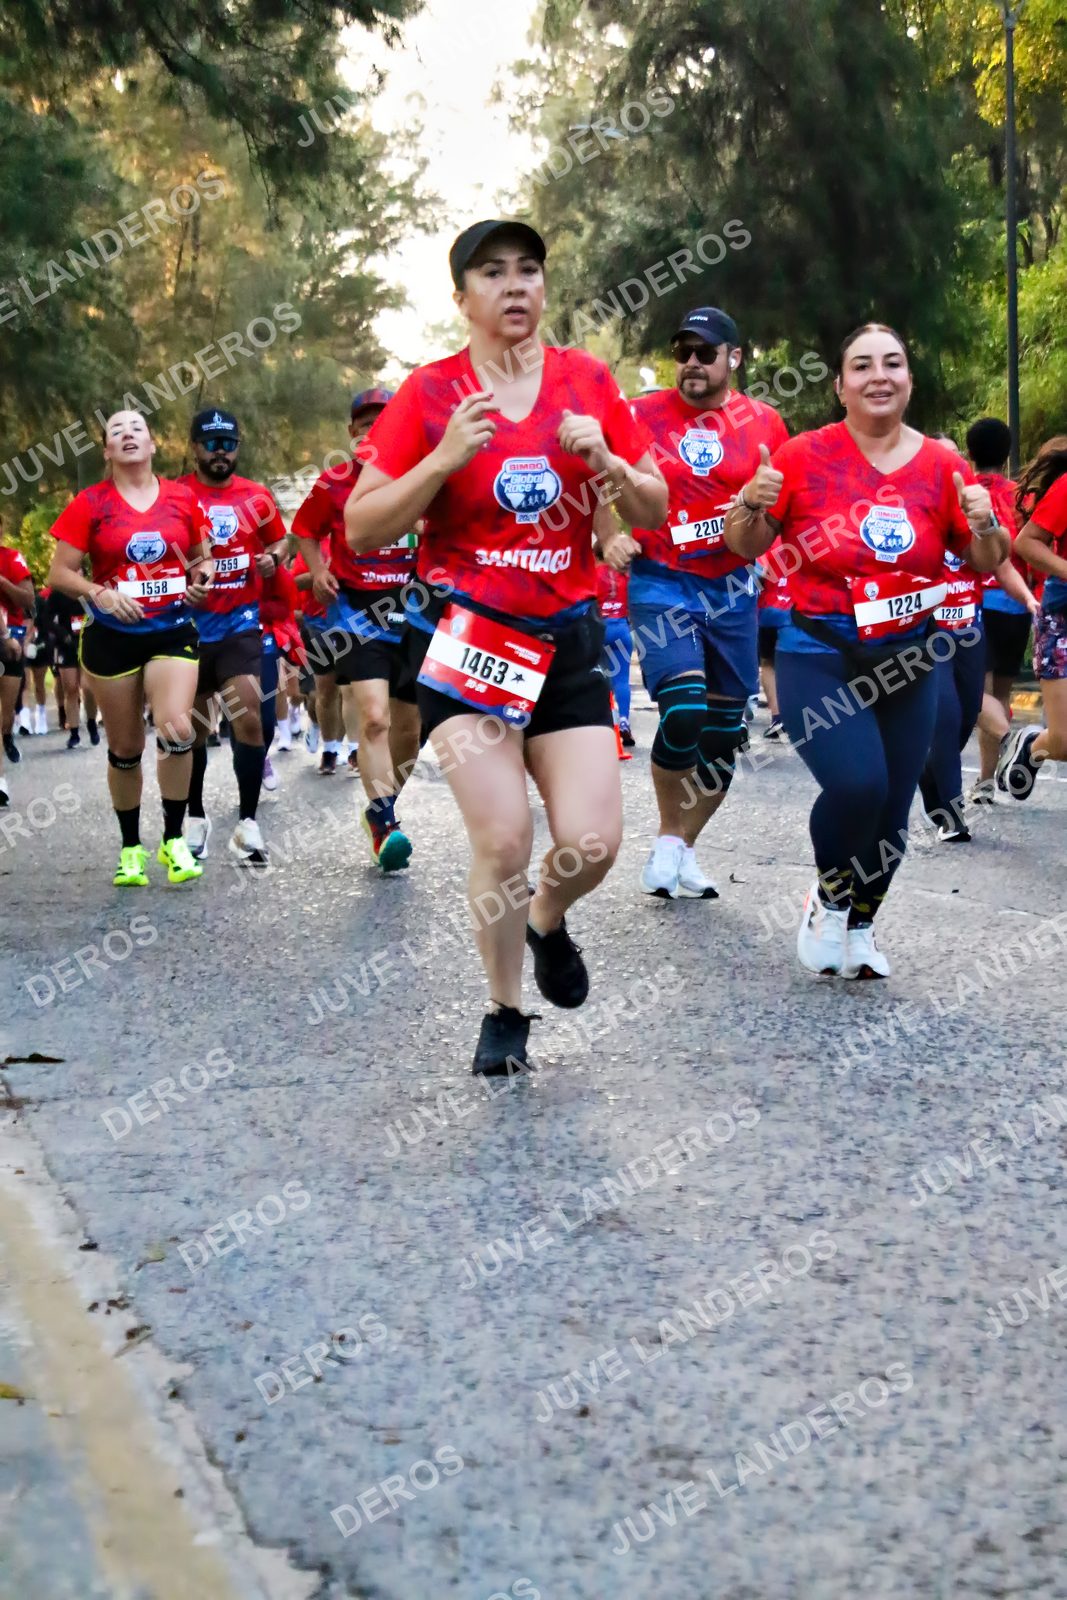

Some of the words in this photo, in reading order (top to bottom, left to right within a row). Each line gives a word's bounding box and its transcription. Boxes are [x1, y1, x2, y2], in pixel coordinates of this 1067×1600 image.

[509, 463, 543, 471] BIMBO
[510, 474, 543, 484] Global
[504, 483, 532, 493] Race
[215, 558, 239, 571] 7559
[475, 546, 571, 574] SANTIAGO
[141, 581, 168, 595] 1558
[887, 593, 922, 618] 1224
[941, 607, 963, 620] 1220
[460, 647, 509, 685] 1463
